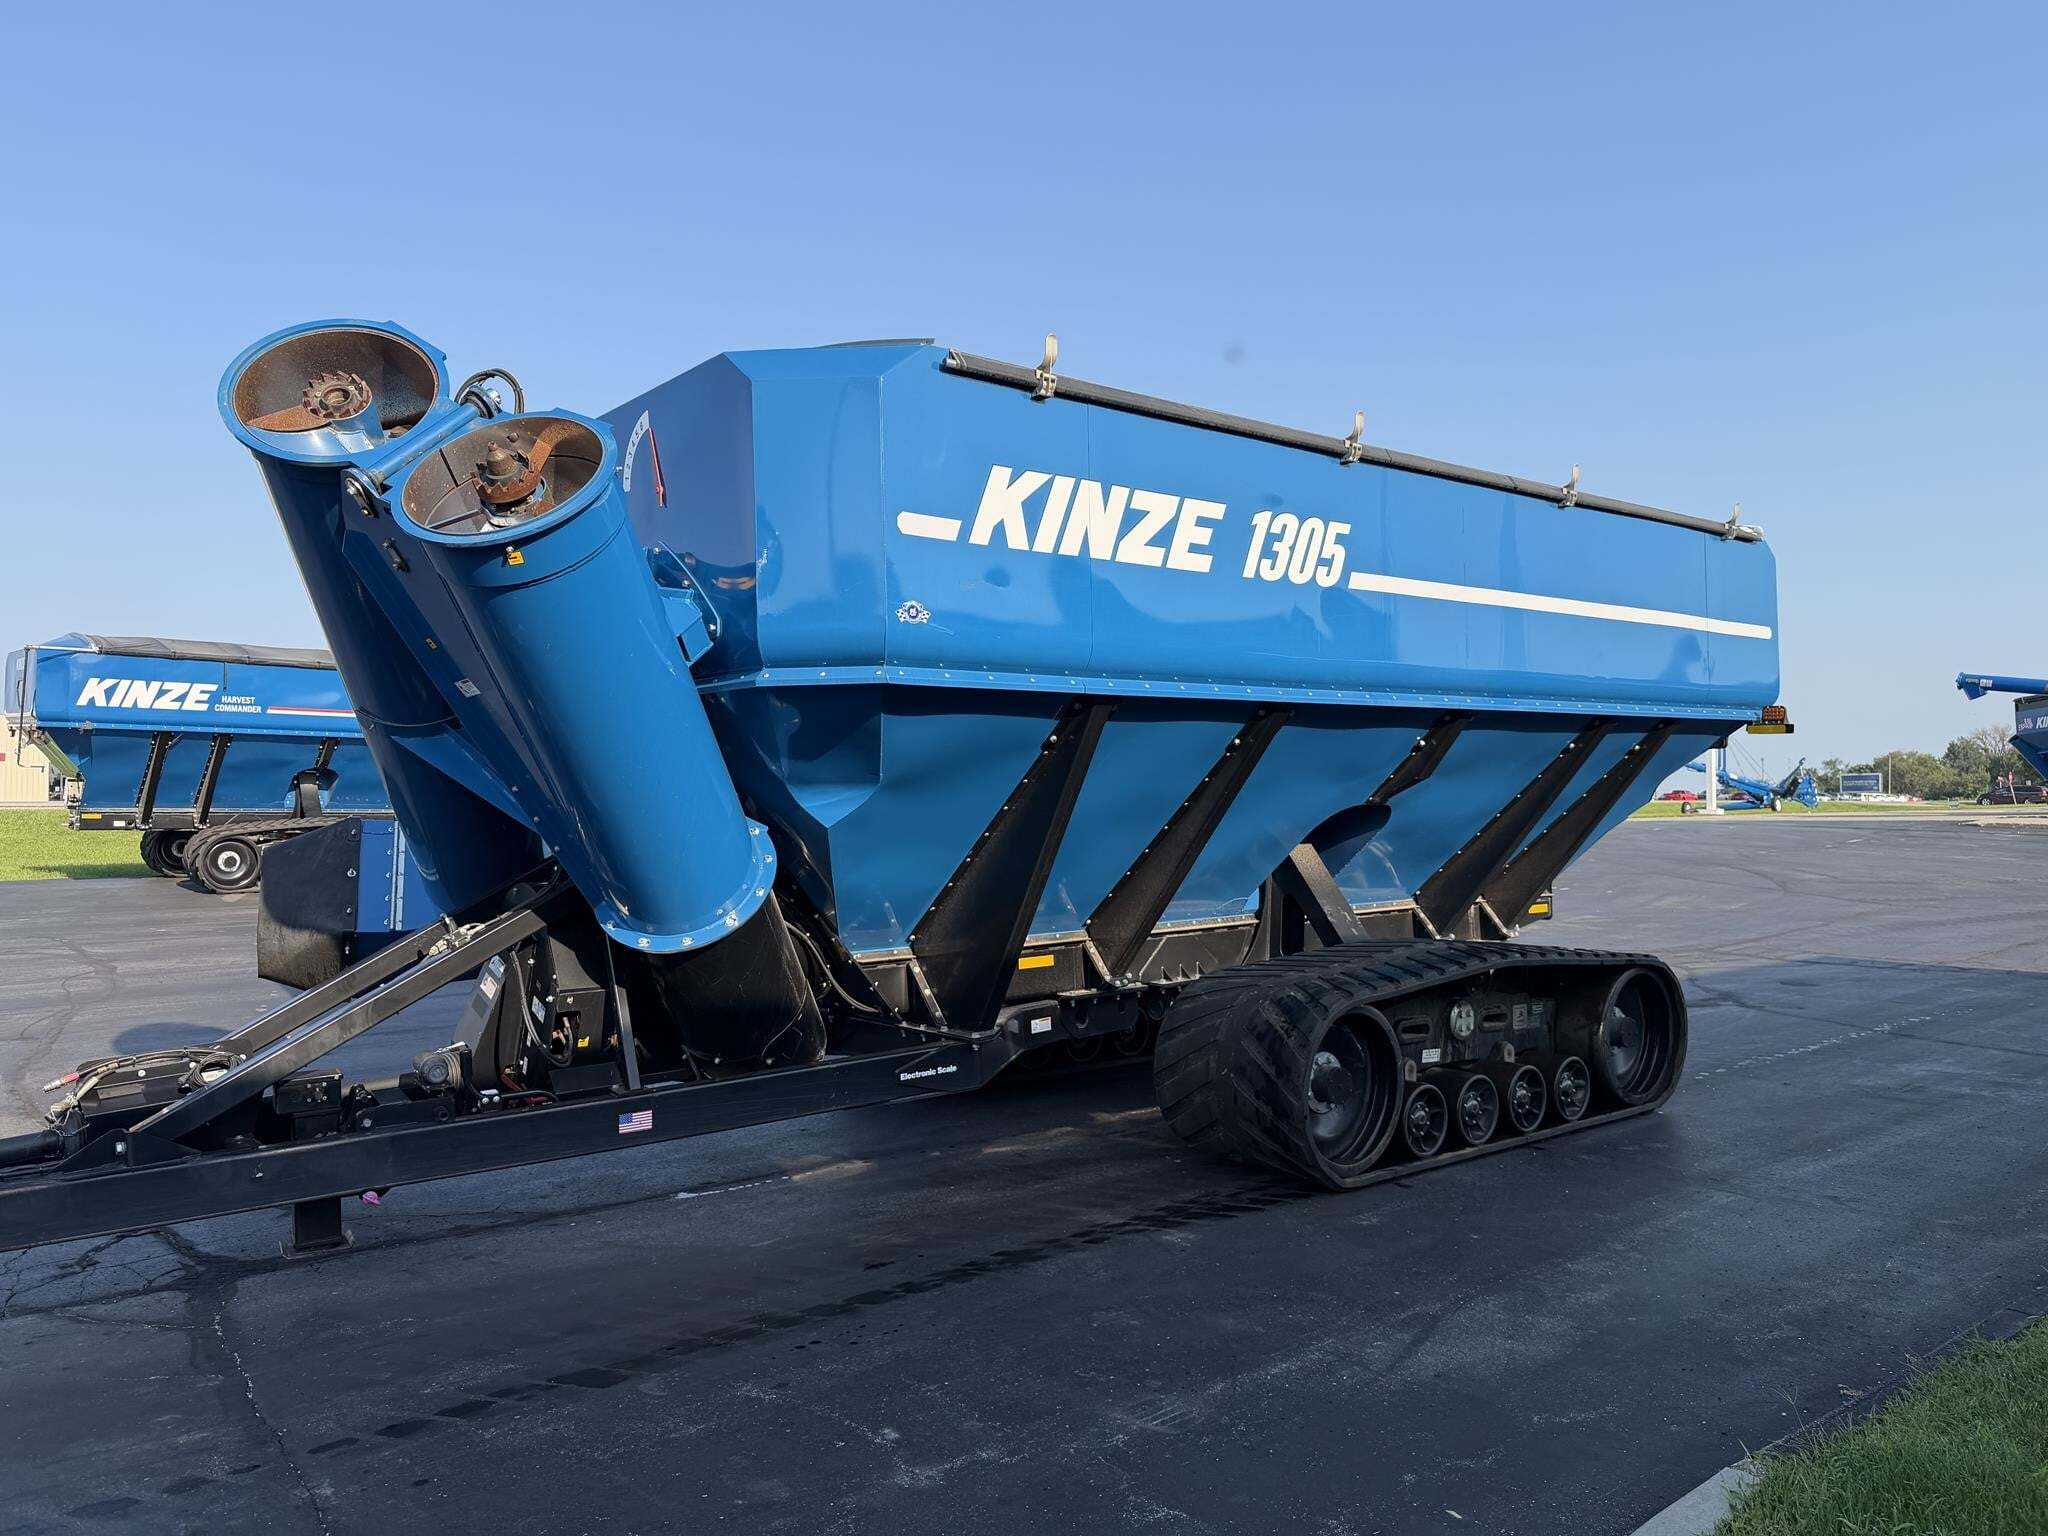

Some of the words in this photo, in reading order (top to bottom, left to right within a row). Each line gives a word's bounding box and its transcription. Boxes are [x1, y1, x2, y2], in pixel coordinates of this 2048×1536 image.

[968, 464, 1226, 573] KINZE
[1242, 510, 1352, 588] 1305
[76, 677, 219, 711] KINZE
[221, 695, 256, 705] HARVEST
[214, 703, 262, 713] COMMANDER
[900, 1067, 937, 1081] Electronic
[937, 1064, 957, 1074] Scale
